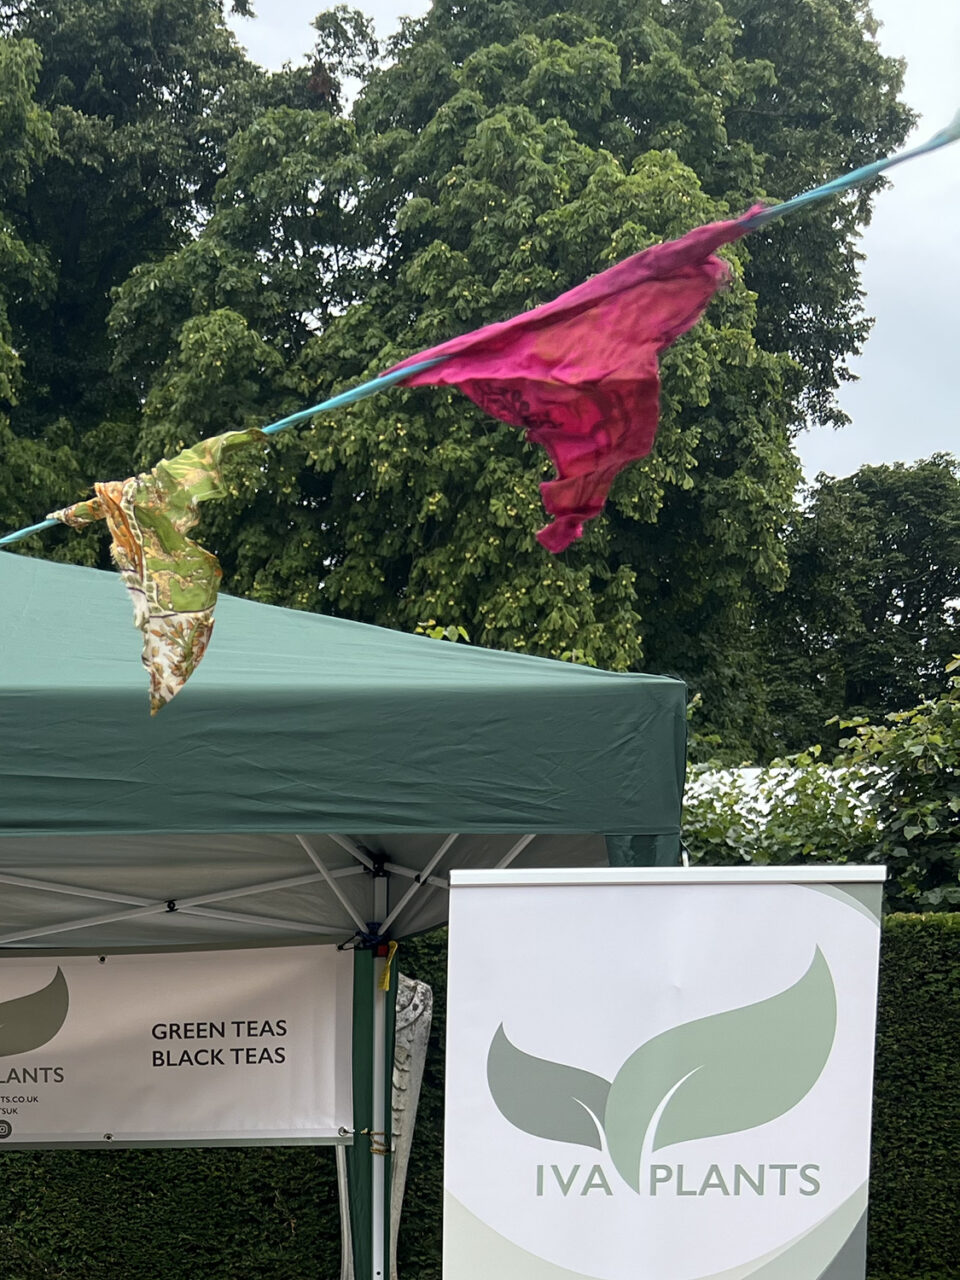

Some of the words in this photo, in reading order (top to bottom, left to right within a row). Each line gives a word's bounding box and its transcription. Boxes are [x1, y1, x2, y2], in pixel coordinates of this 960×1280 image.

[151, 1021, 226, 1040] GREEN
[230, 1019, 287, 1038] TEAS
[152, 1048, 225, 1067] BLACK
[229, 1046, 286, 1065] TEAS
[536, 1164, 614, 1197] IVA
[650, 1164, 820, 1196] PLANTS
